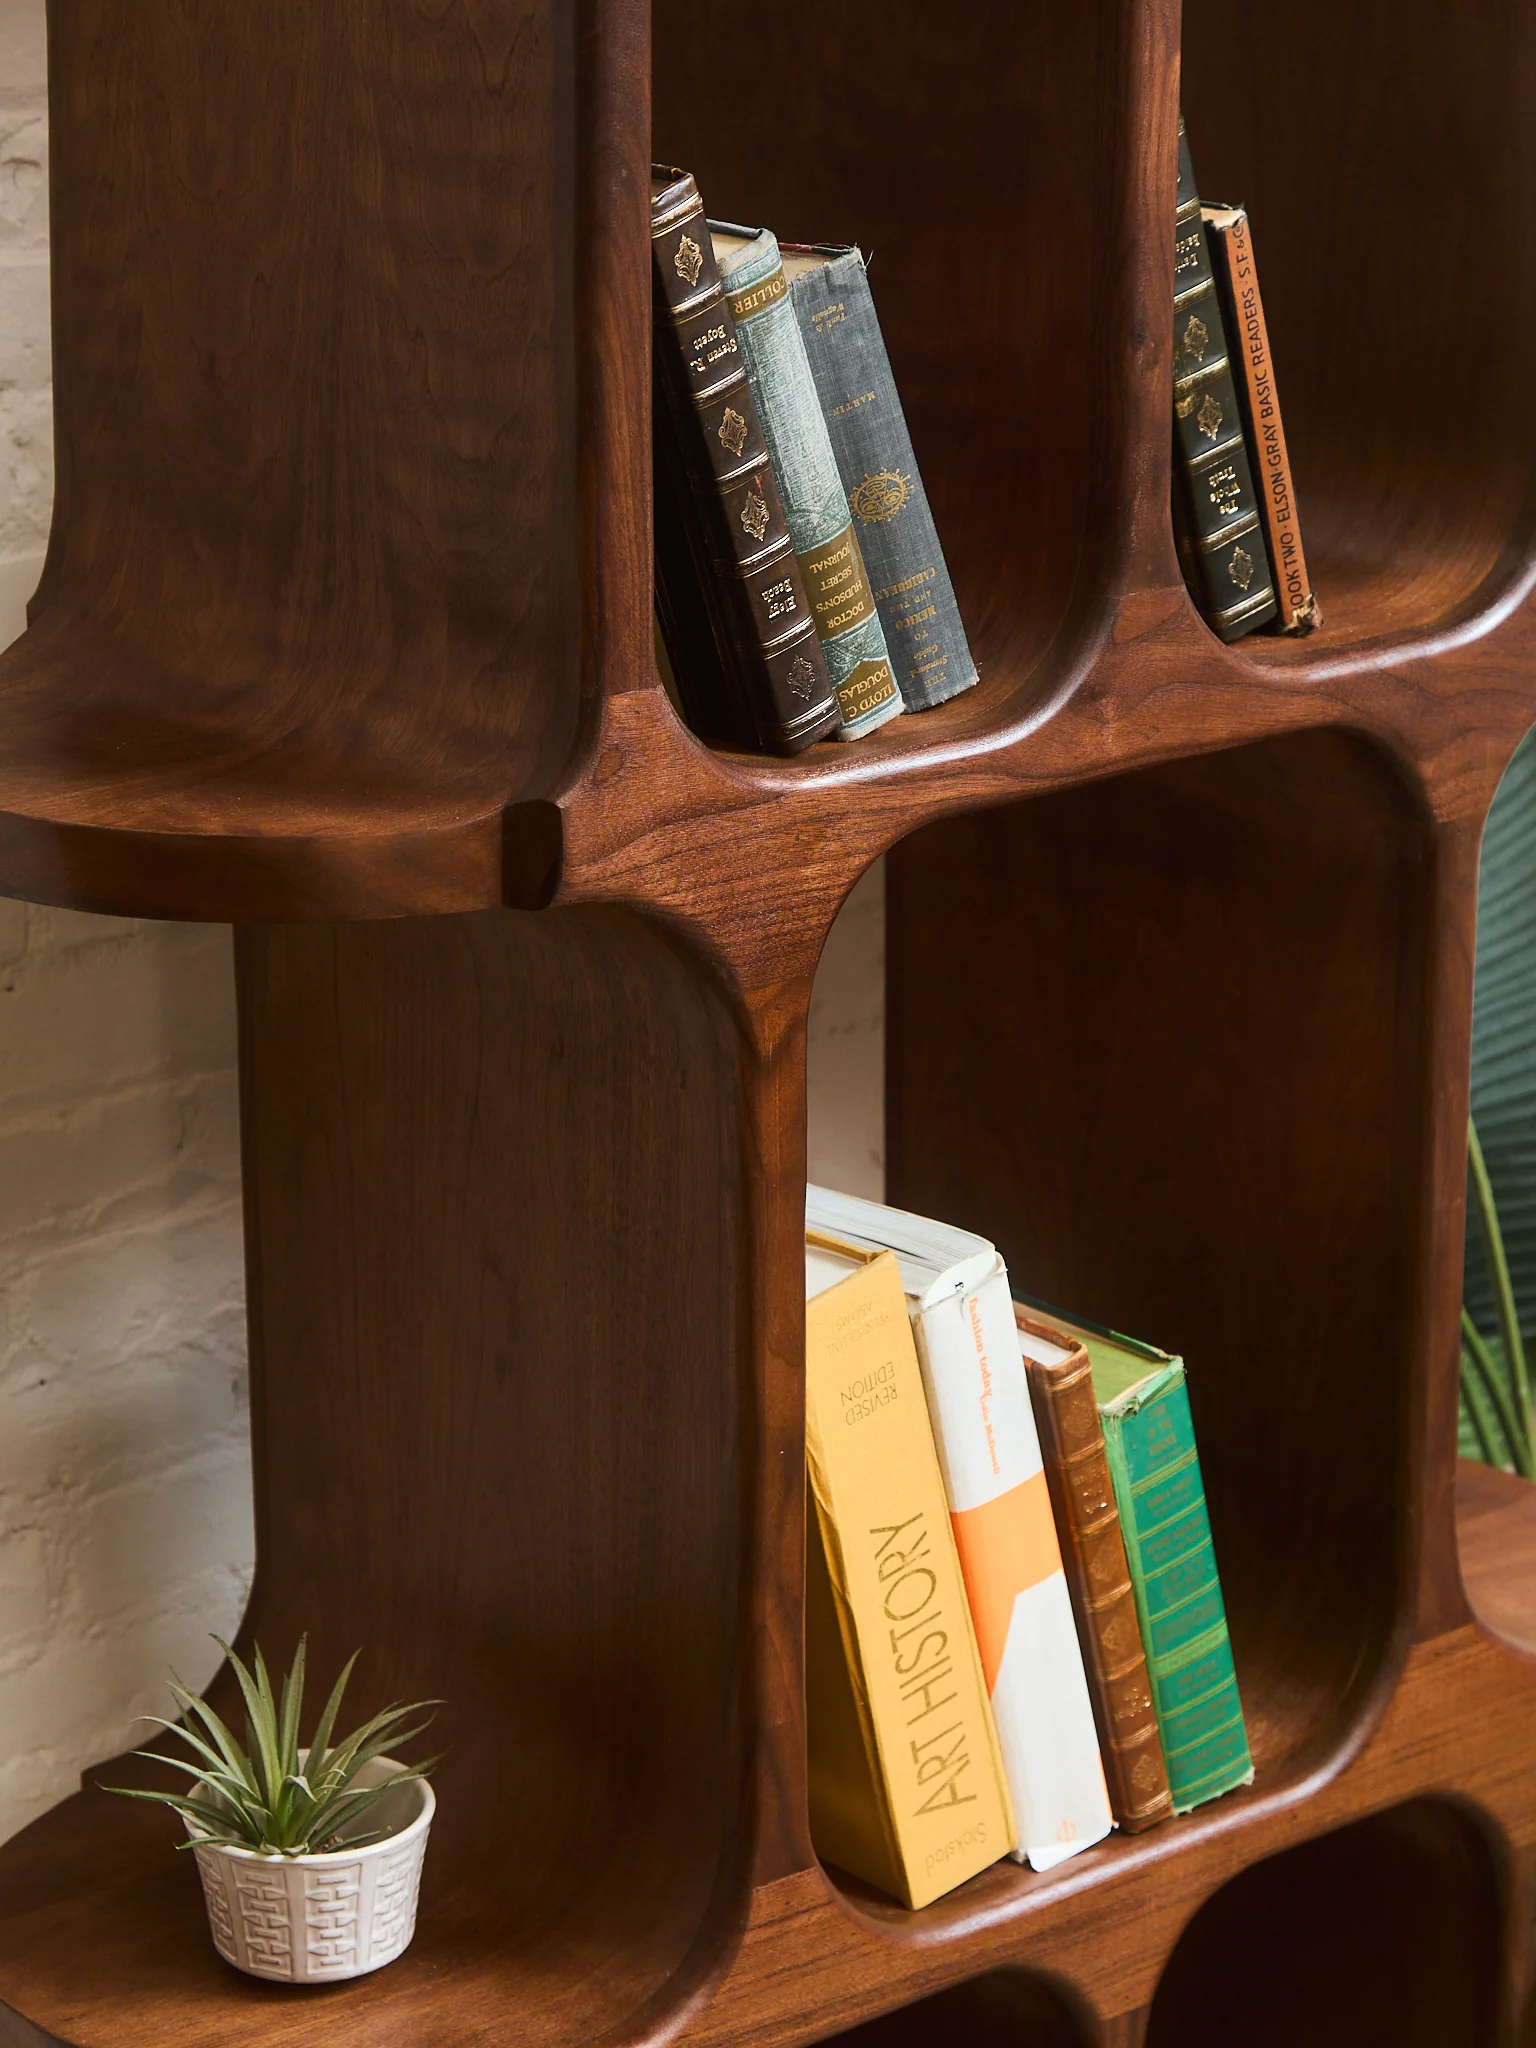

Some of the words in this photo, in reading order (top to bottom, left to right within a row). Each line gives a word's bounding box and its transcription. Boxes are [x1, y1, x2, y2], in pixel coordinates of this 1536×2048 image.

[1175, 253, 1198, 274] Davi
[734, 274, 786, 314] COLLIER
[1242, 287, 1265, 367] READERS
[832, 391, 876, 417] MARTIN
[1255, 369, 1274, 419] BASIC
[809, 541, 850, 574] JOURNAL
[1280, 531, 1299, 570] TWO
[820, 565, 853, 591] SECRET
[875, 567, 936, 601] CARIBBEAN
[816, 579, 863, 613] HUDSON'S
[914, 589, 932, 603] AND
[827, 601, 865, 629] DOCTOR
[896, 604, 937, 630] MEXICO
[914, 630, 929, 641] TO
[839, 666, 889, 702] DOUGLAS
[859, 684, 893, 711] LLOYD
[845, 705, 857, 718] C.
[969, 1296, 984, 1353] fashion
[979, 1355, 992, 1398] today
[841, 1362, 895, 1406] EDITION
[845, 1383, 898, 1426] REVISED
[869, 1512, 958, 1727] HISTORY
[912, 1720, 978, 1817] ART
[925, 1823, 987, 1877] Stokstad
